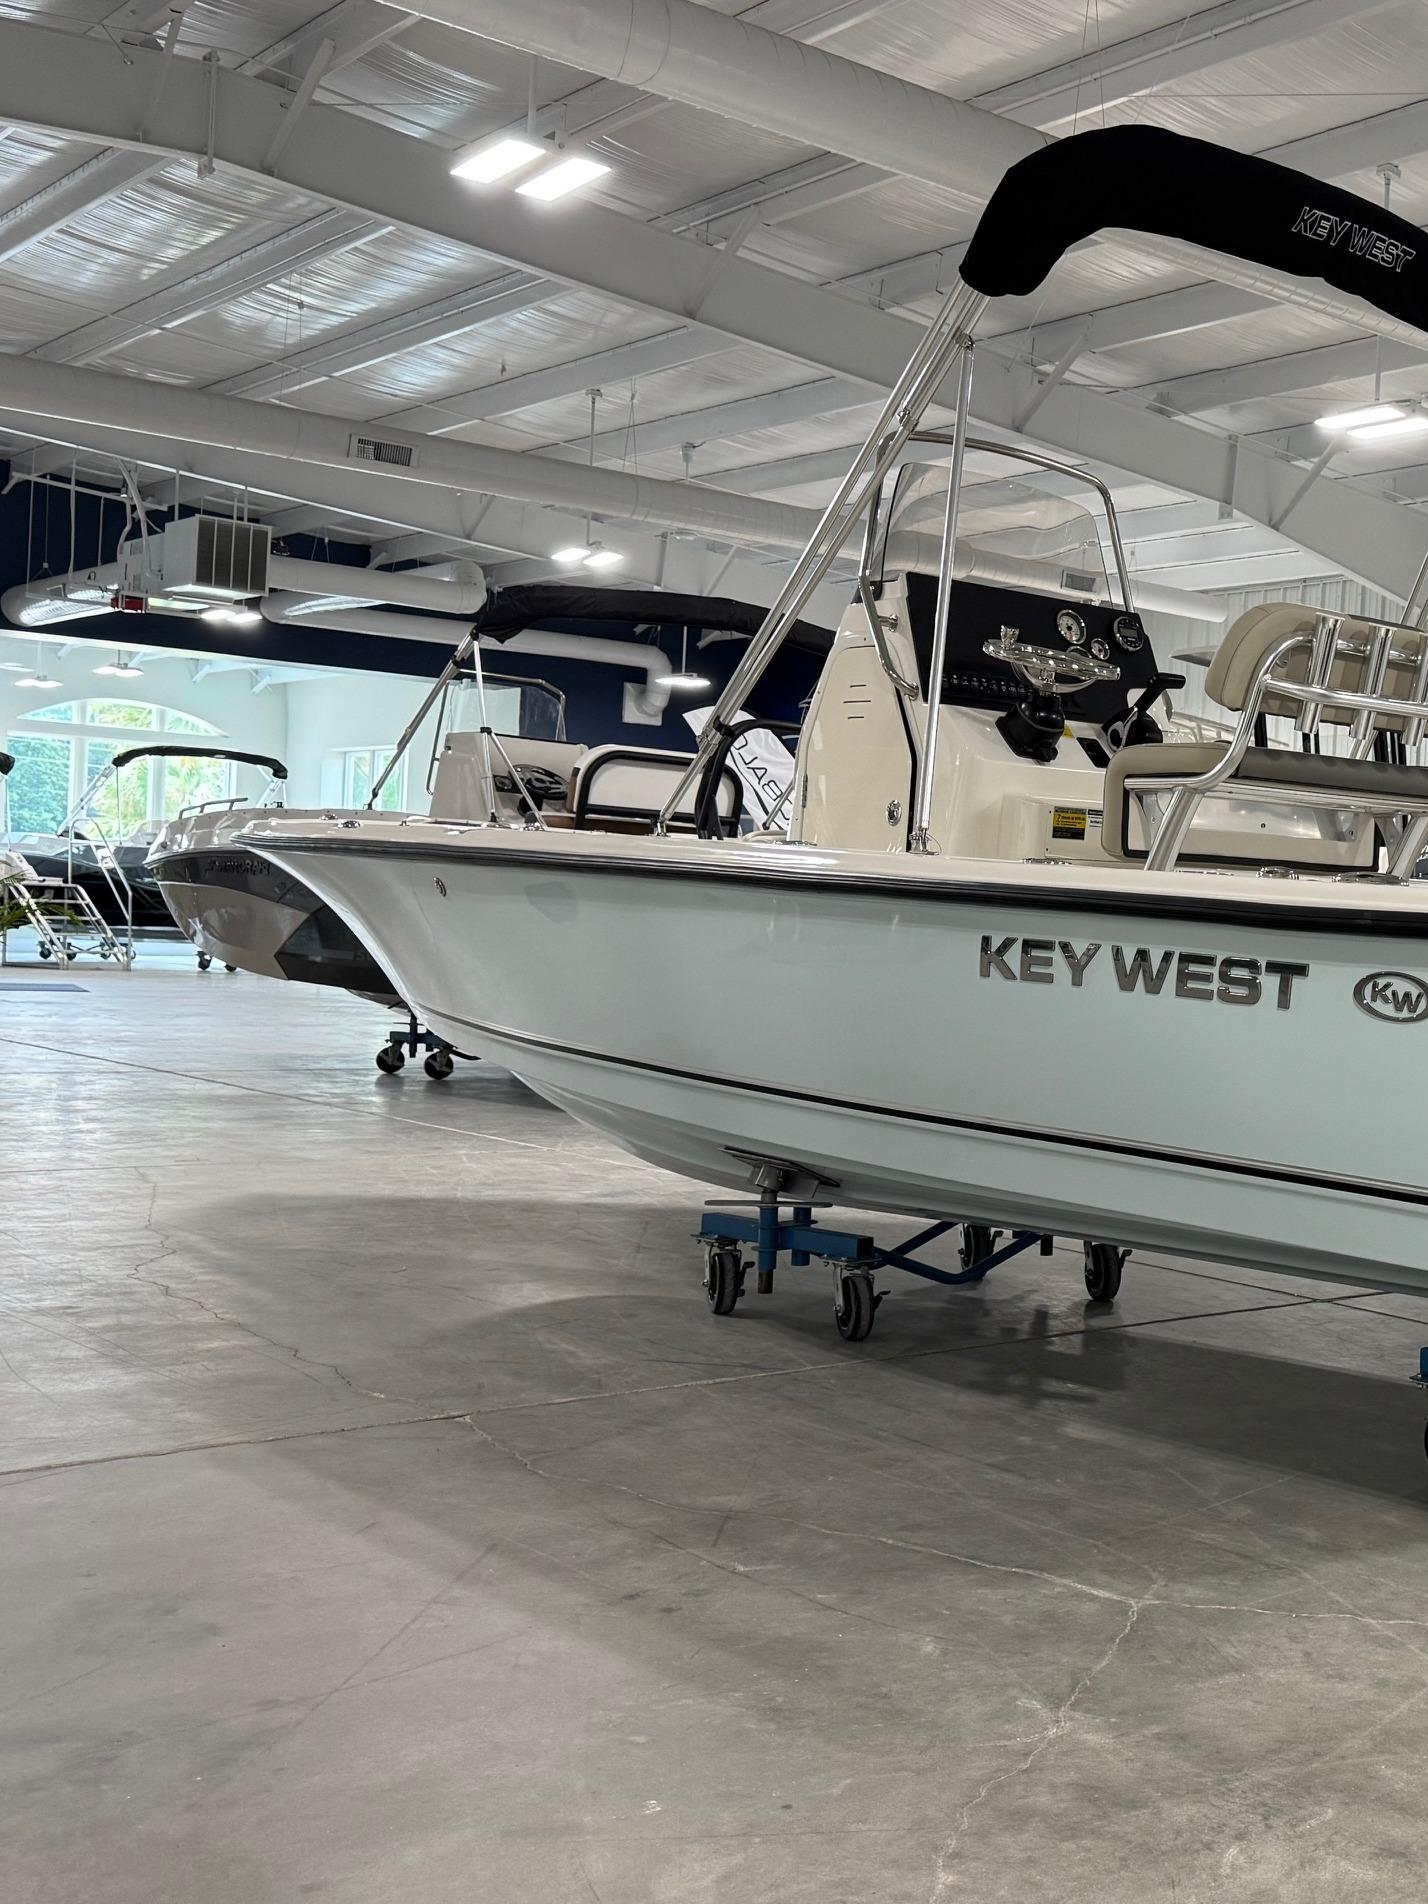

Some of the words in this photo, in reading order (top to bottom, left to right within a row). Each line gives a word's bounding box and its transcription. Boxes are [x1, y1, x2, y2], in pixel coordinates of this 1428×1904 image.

[1291, 206, 1352, 246] KEY
[1348, 224, 1417, 272] WEST
[979, 935, 1102, 987] KEY
[1111, 945, 1310, 1010] WEST
[1370, 979, 1426, 1015] KW
